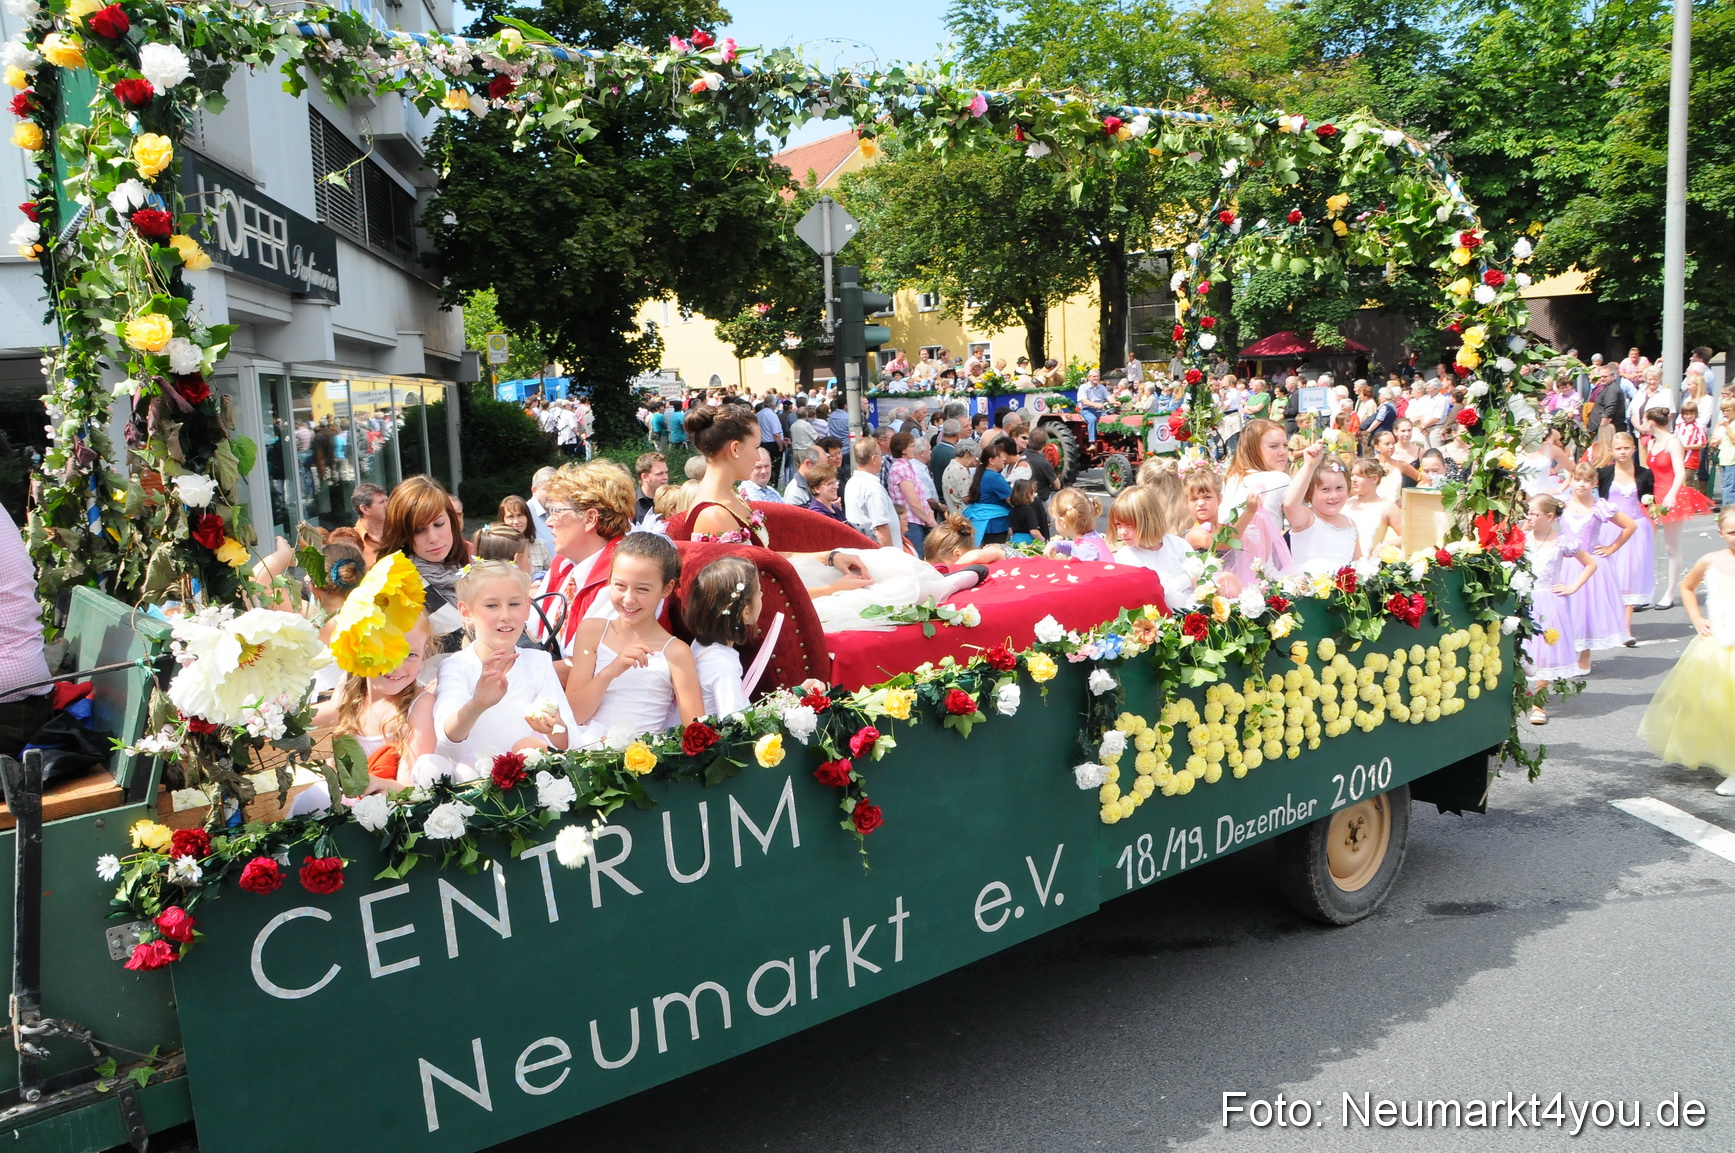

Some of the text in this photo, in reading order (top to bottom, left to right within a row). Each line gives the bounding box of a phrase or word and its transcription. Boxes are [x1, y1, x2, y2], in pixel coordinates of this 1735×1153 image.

[197, 174, 291, 275] HOFER
[1099, 620, 1503, 824] DORNRÖSCHEN
[1216, 793, 1318, 855] Dezember
[1330, 756, 1393, 810] 2010
[250, 775, 801, 1000] CENTRUM
[418, 844, 1065, 1133] Neumarkt e.V.
